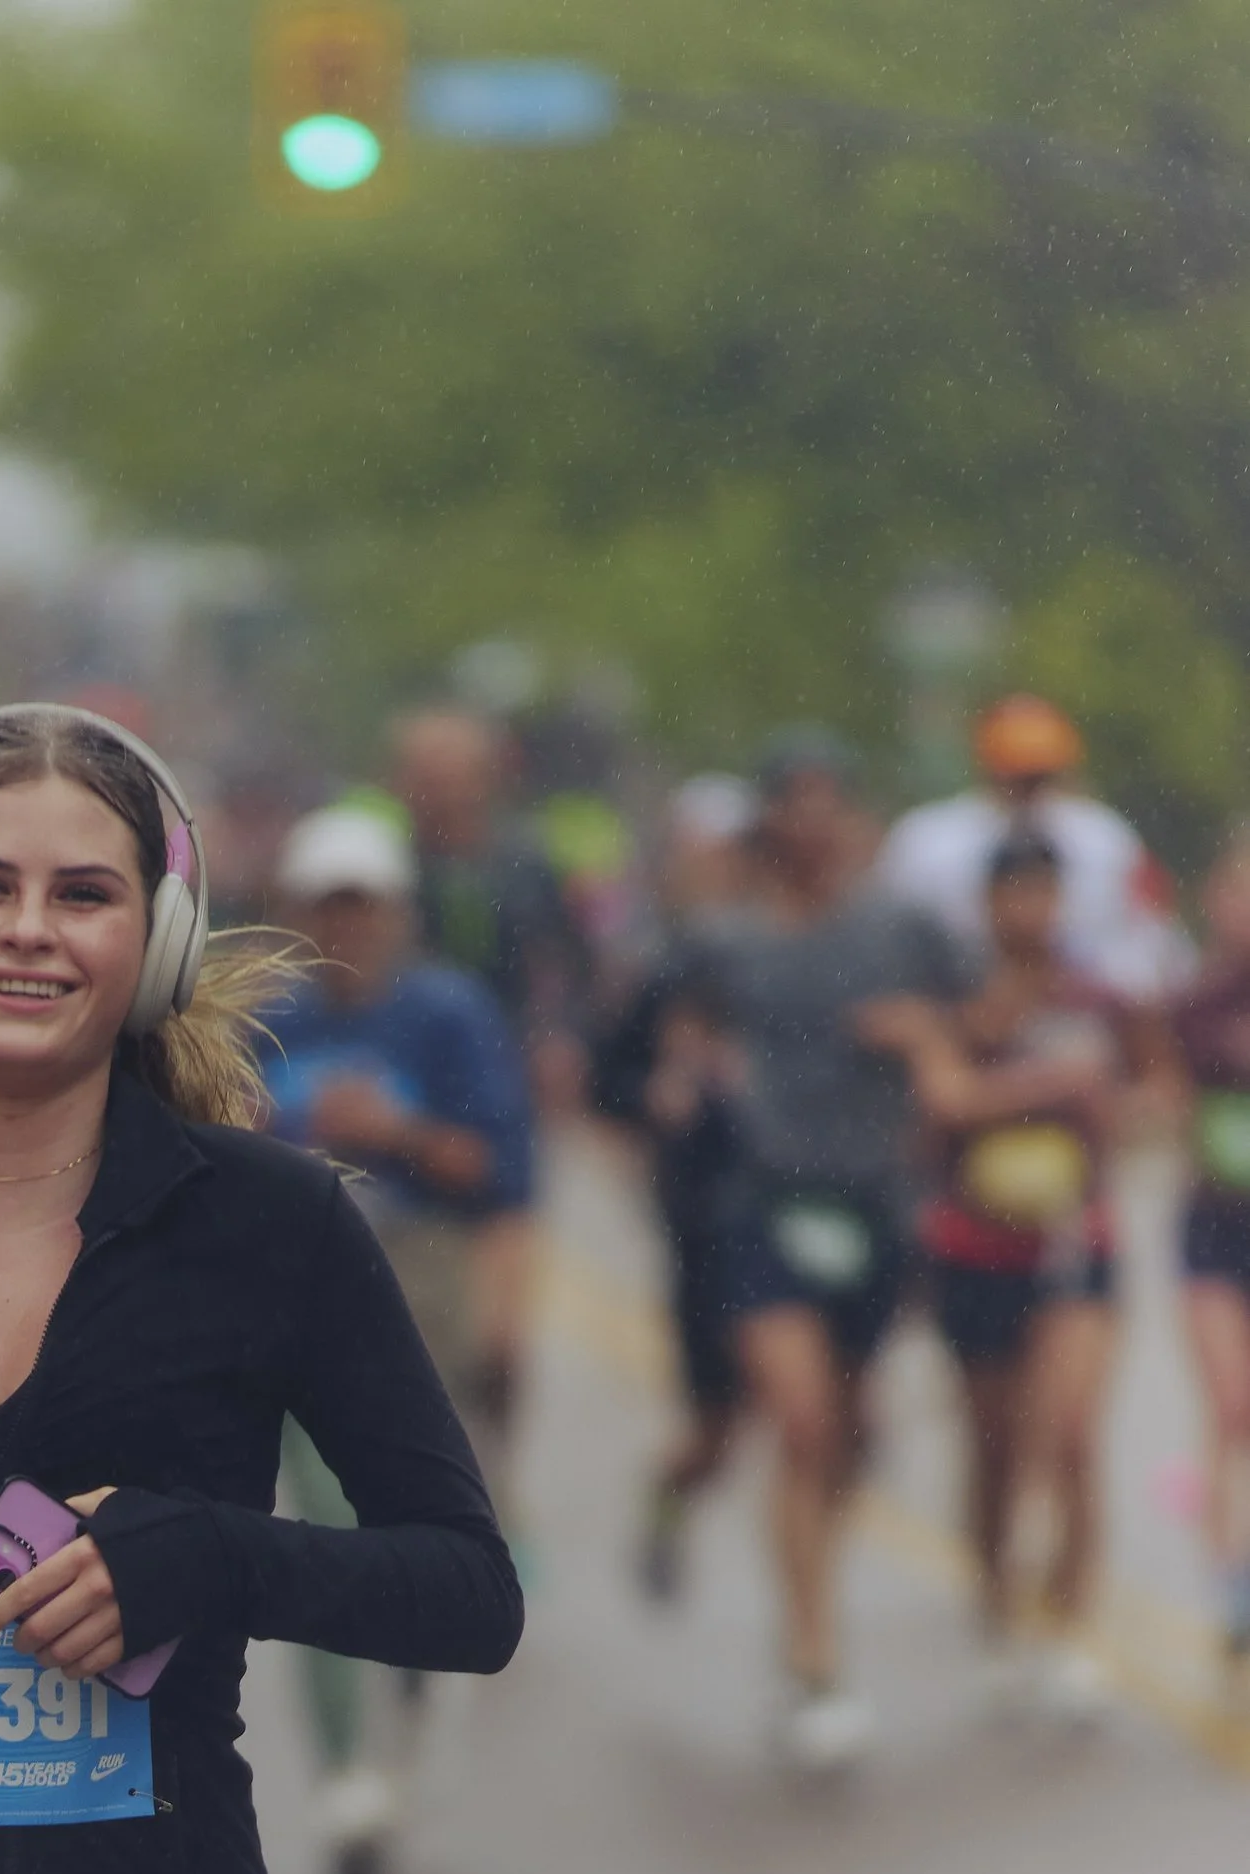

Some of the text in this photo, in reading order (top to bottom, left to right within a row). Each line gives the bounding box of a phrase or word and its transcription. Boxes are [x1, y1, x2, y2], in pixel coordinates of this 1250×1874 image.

[23, 1761, 76, 1775] YEARS
[98, 1753, 125, 1769] RUN
[23, 1773, 69, 1786] BOLD
